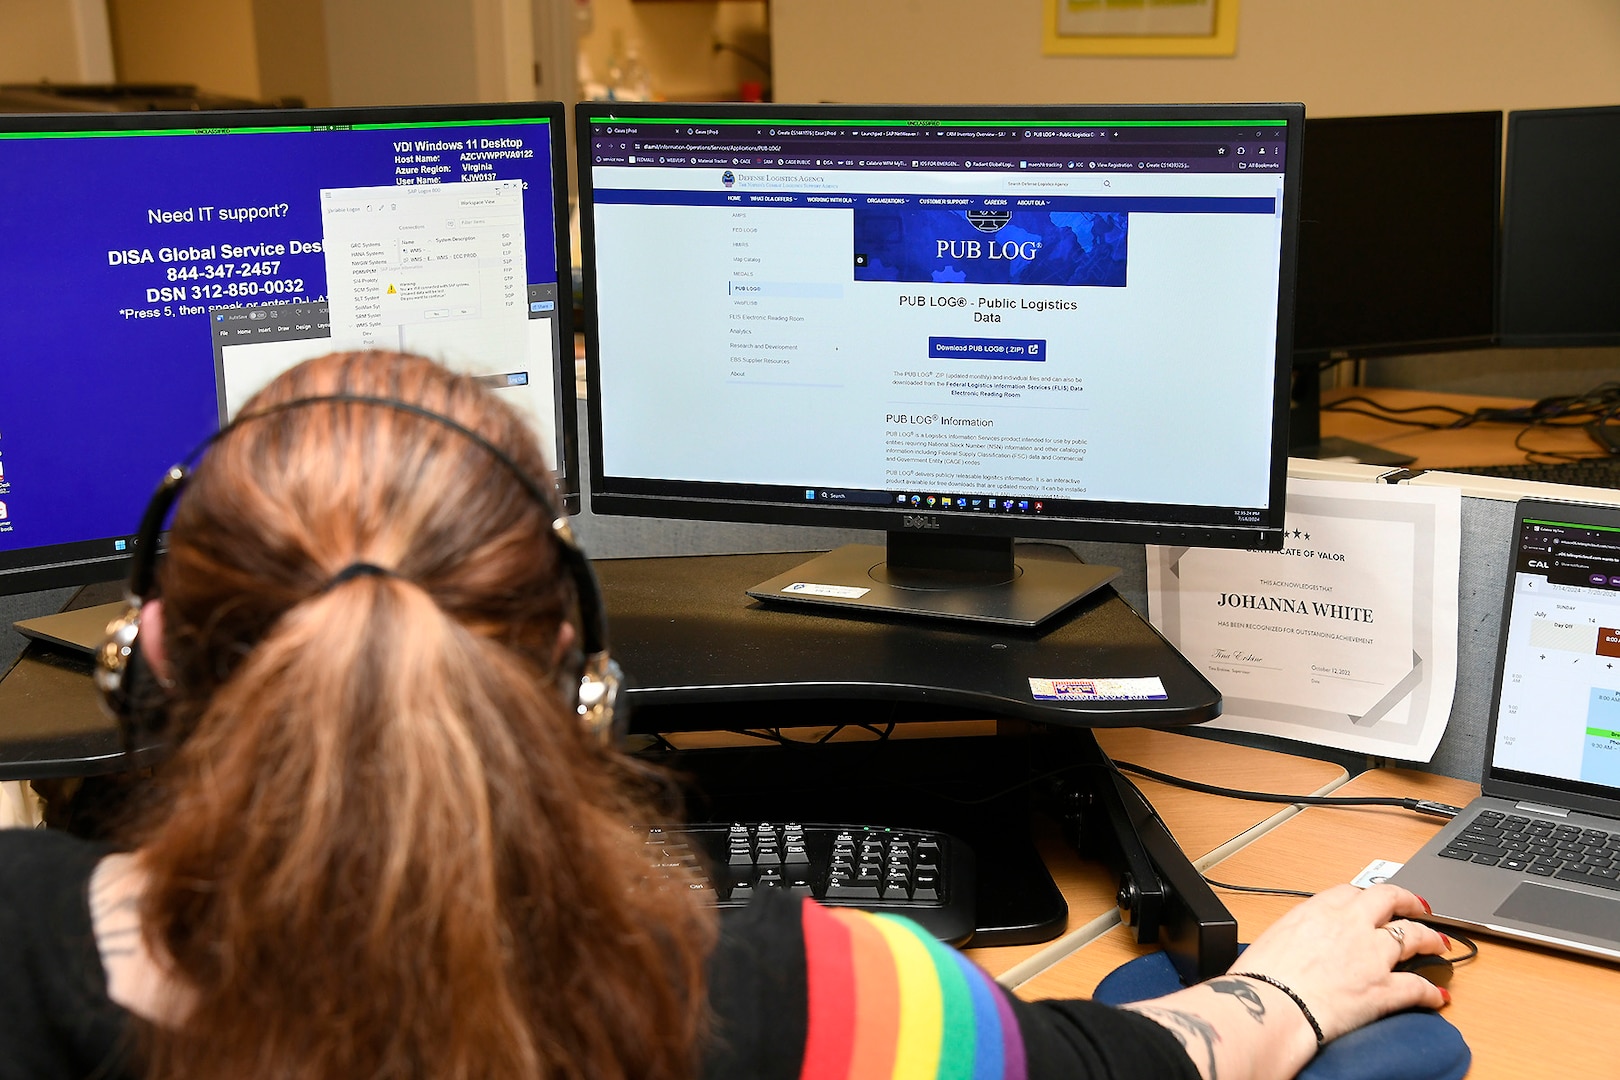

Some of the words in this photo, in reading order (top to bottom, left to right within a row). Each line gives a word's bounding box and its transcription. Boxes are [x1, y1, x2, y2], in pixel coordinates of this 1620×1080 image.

[393, 141, 412, 152] VDI
[414, 140, 463, 152] Windows
[466, 139, 478, 150] 11
[481, 138, 522, 151] Desktop
[395, 156, 415, 164] Host
[416, 155, 440, 164] Name:
[395, 166, 418, 175] Azure
[420, 165, 451, 175] Region:
[462, 163, 492, 172] Virginia
[396, 177, 414, 185] User
[416, 176, 441, 184] Name:
[147, 207, 193, 224] Need
[199, 206, 214, 221] IT
[219, 203, 289, 227] support?
[108, 249, 153, 265] DISA
[159, 246, 215, 262] Global
[221, 243, 284, 258] Service
[290, 240, 324, 254] Des
[936, 240, 980, 259] PUB
[167, 260, 280, 282] 844-347-2457
[146, 285, 186, 303] DSN
[191, 279, 304, 299] 312-850-0032
[899, 296, 926, 307] PUB
[978, 297, 1017, 309] Public
[1021, 299, 1077, 311] Logistics
[164, 306, 176, 318] 5,
[179, 304, 205, 315] then
[974, 312, 1001, 323] Data
[296, 323, 311, 331] Design
[936, 344, 967, 352] Download
[968, 344, 983, 352] PUB
[886, 414, 907, 424] PUB
[941, 416, 993, 427] Information
[904, 515, 939, 529] DELL
[1303, 549, 1315, 558] OF
[1317, 551, 1345, 562] VALOR
[1273, 581, 1318, 590] ACKNOWLEDGES
[1217, 592, 1307, 615] JOHANNA
[1311, 601, 1373, 624] WHITE
[1230, 621, 1245, 629] BEEN
[1246, 623, 1283, 633] RECOGNIZED
[1296, 629, 1335, 639] OUTSTANDING
[1335, 635, 1373, 644] ACHIEVEMENT
[1311, 664, 1330, 673] October
[1339, 668, 1350, 676] 2022
